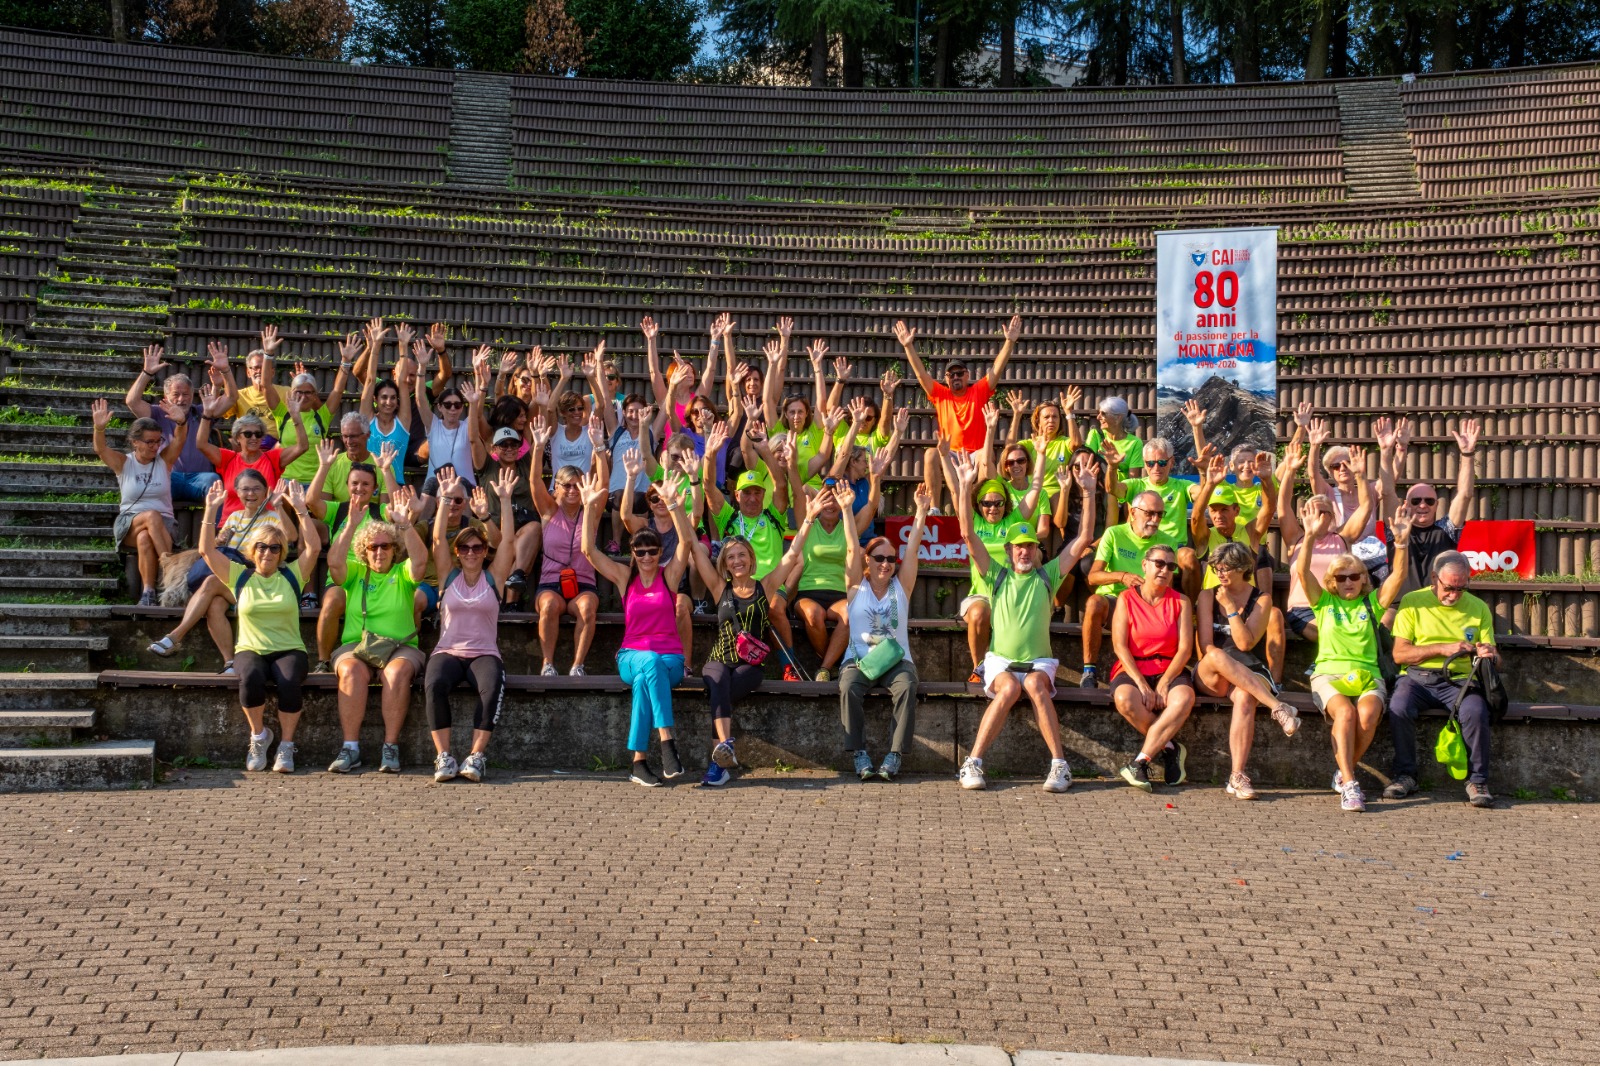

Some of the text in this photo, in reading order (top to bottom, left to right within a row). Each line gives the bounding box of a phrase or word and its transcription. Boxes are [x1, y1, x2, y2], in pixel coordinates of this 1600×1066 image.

[1211, 249, 1234, 266] CAI
[1193, 270, 1240, 308] 80
[1196, 307, 1237, 328] anni
[1174, 329, 1259, 343] di passione per la
[1178, 342, 1255, 358] MONTAGNA
